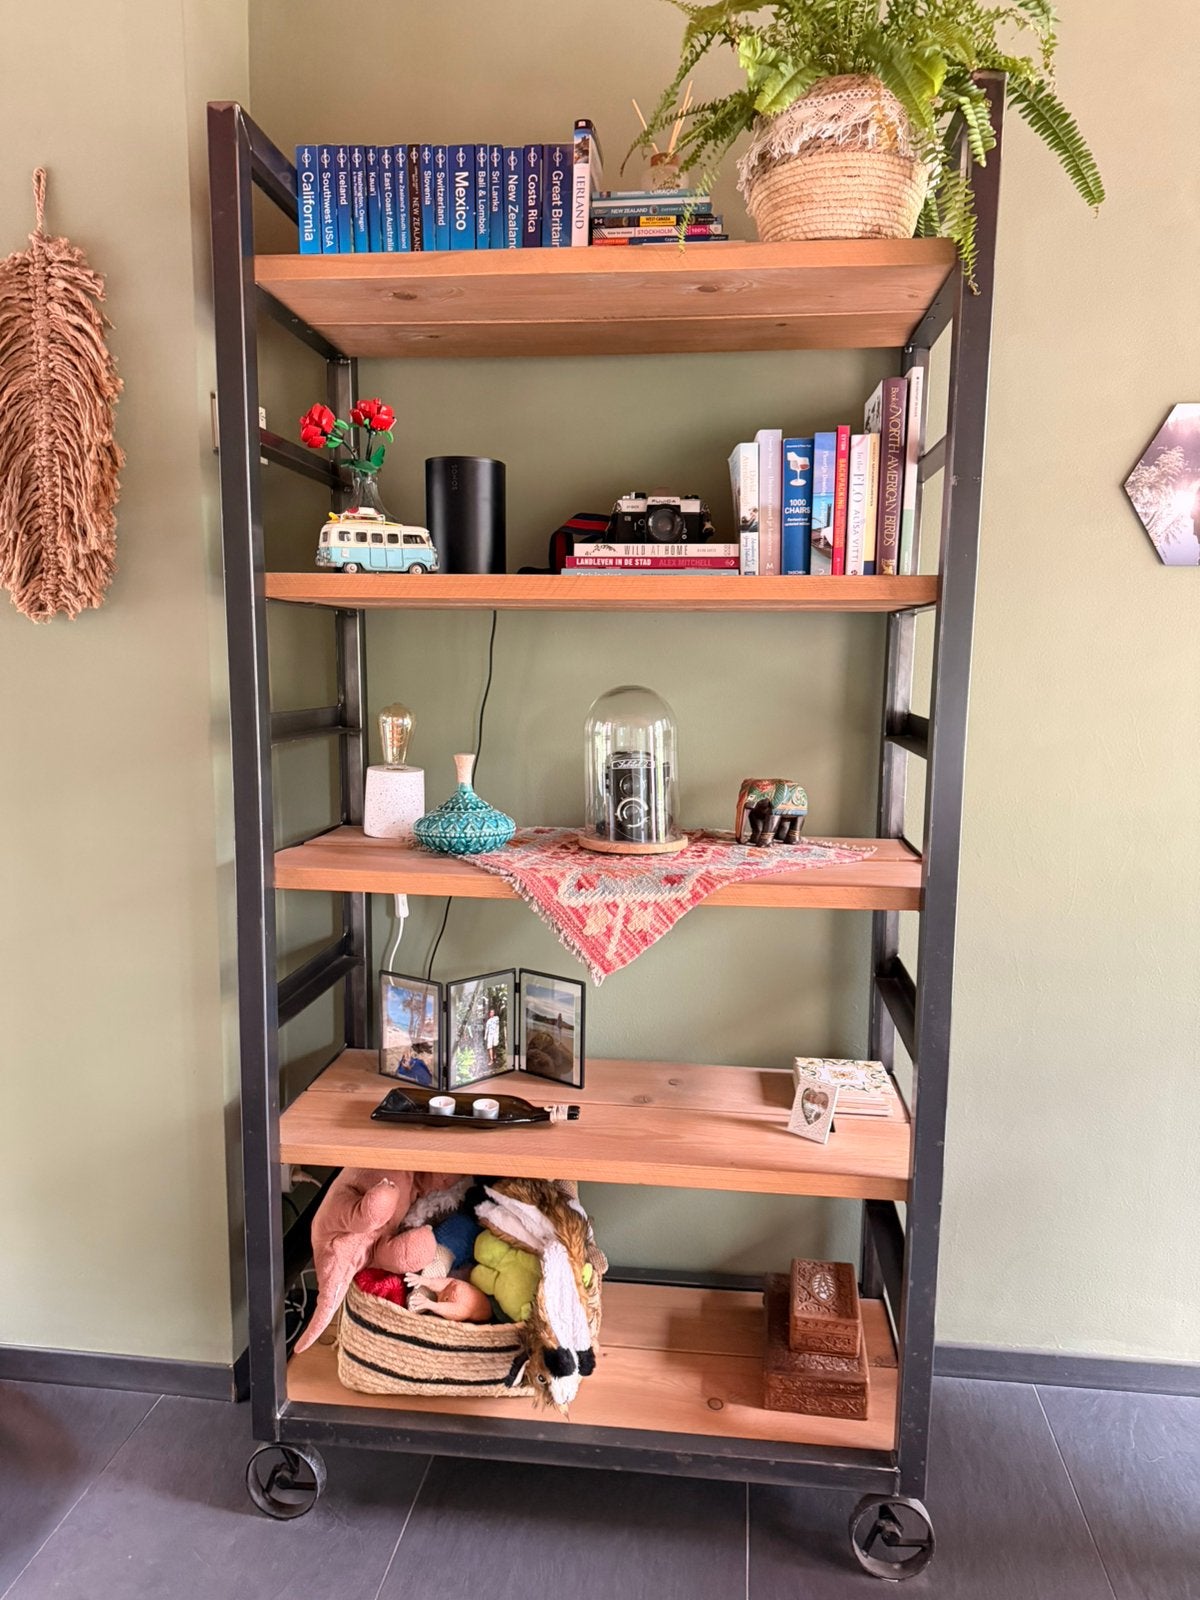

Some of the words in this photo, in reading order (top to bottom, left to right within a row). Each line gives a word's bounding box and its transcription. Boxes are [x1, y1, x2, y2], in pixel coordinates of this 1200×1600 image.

[339, 172, 348, 205] Iceland
[492, 170, 500, 184] Sri
[508, 175, 518, 202] New
[528, 174, 538, 206] Costa
[552, 170, 563, 206] Great
[302, 172, 316, 241] California
[322, 172, 332, 224] Southwest
[436, 172, 446, 226] Switzerland
[455, 172, 469, 230] Mexico
[576, 176, 585, 230] IERLAND
[386, 216, 394, 252] Australia
[478, 200, 486, 235] Lombok
[528, 209, 538, 233] Rica
[325, 226, 334, 248] USA
[888, 408, 902, 452] NORTH
[838, 458, 846, 510] BACKPACKING
[853, 473, 864, 503] FLO
[885, 455, 900, 513] AMERICAN
[883, 515, 897, 546] BIRDS
[624, 545, 646, 555] WILD
[651, 545, 660, 555] AT
[664, 545, 688, 555] HOME
